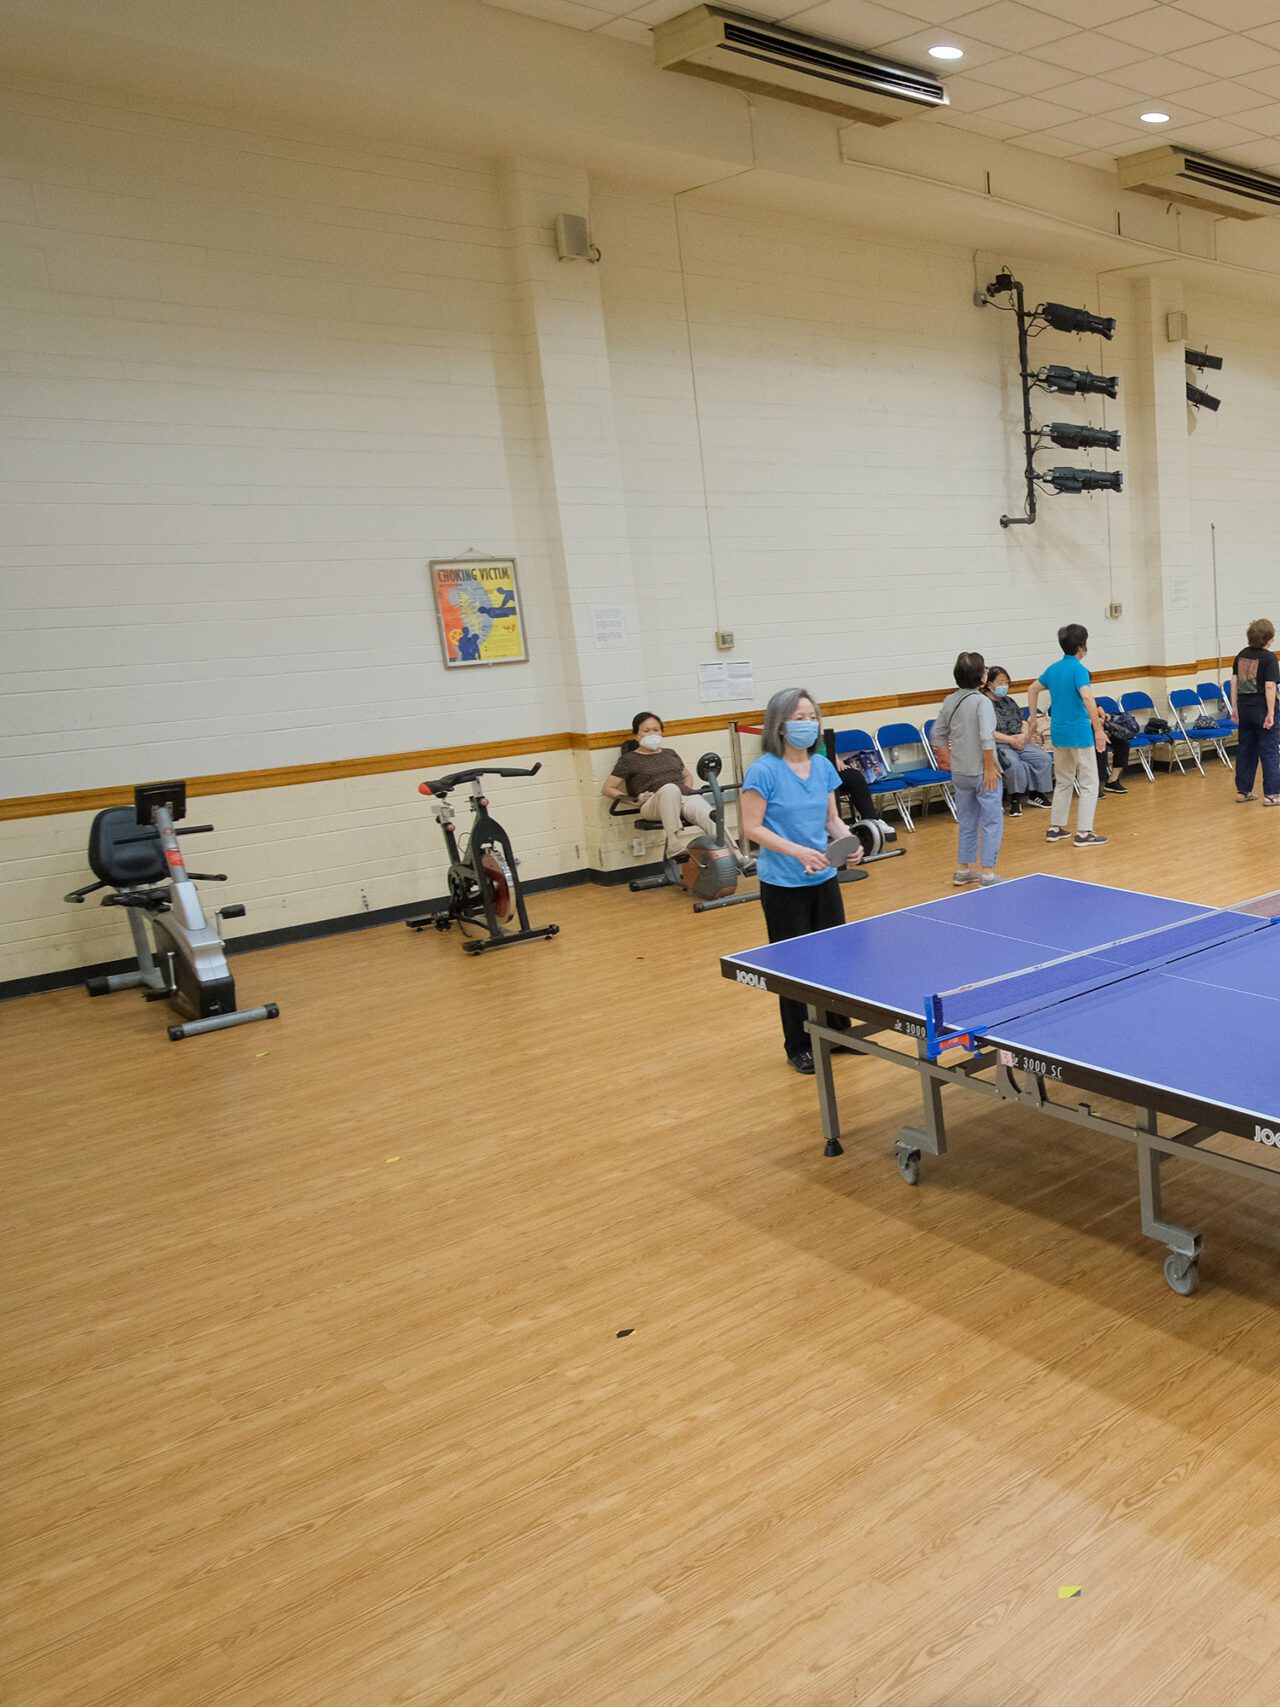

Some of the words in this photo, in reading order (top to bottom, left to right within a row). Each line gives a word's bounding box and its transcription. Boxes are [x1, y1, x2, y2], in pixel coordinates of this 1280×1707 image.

[438, 569, 477, 582] CHOKING
[480, 567, 510, 580] VICTIM
[736, 969, 767, 990] JOOLA
[906, 1022, 926, 1038] 3000
[1023, 1057, 1046, 1074] 3000
[1051, 1065, 1063, 1079] SC
